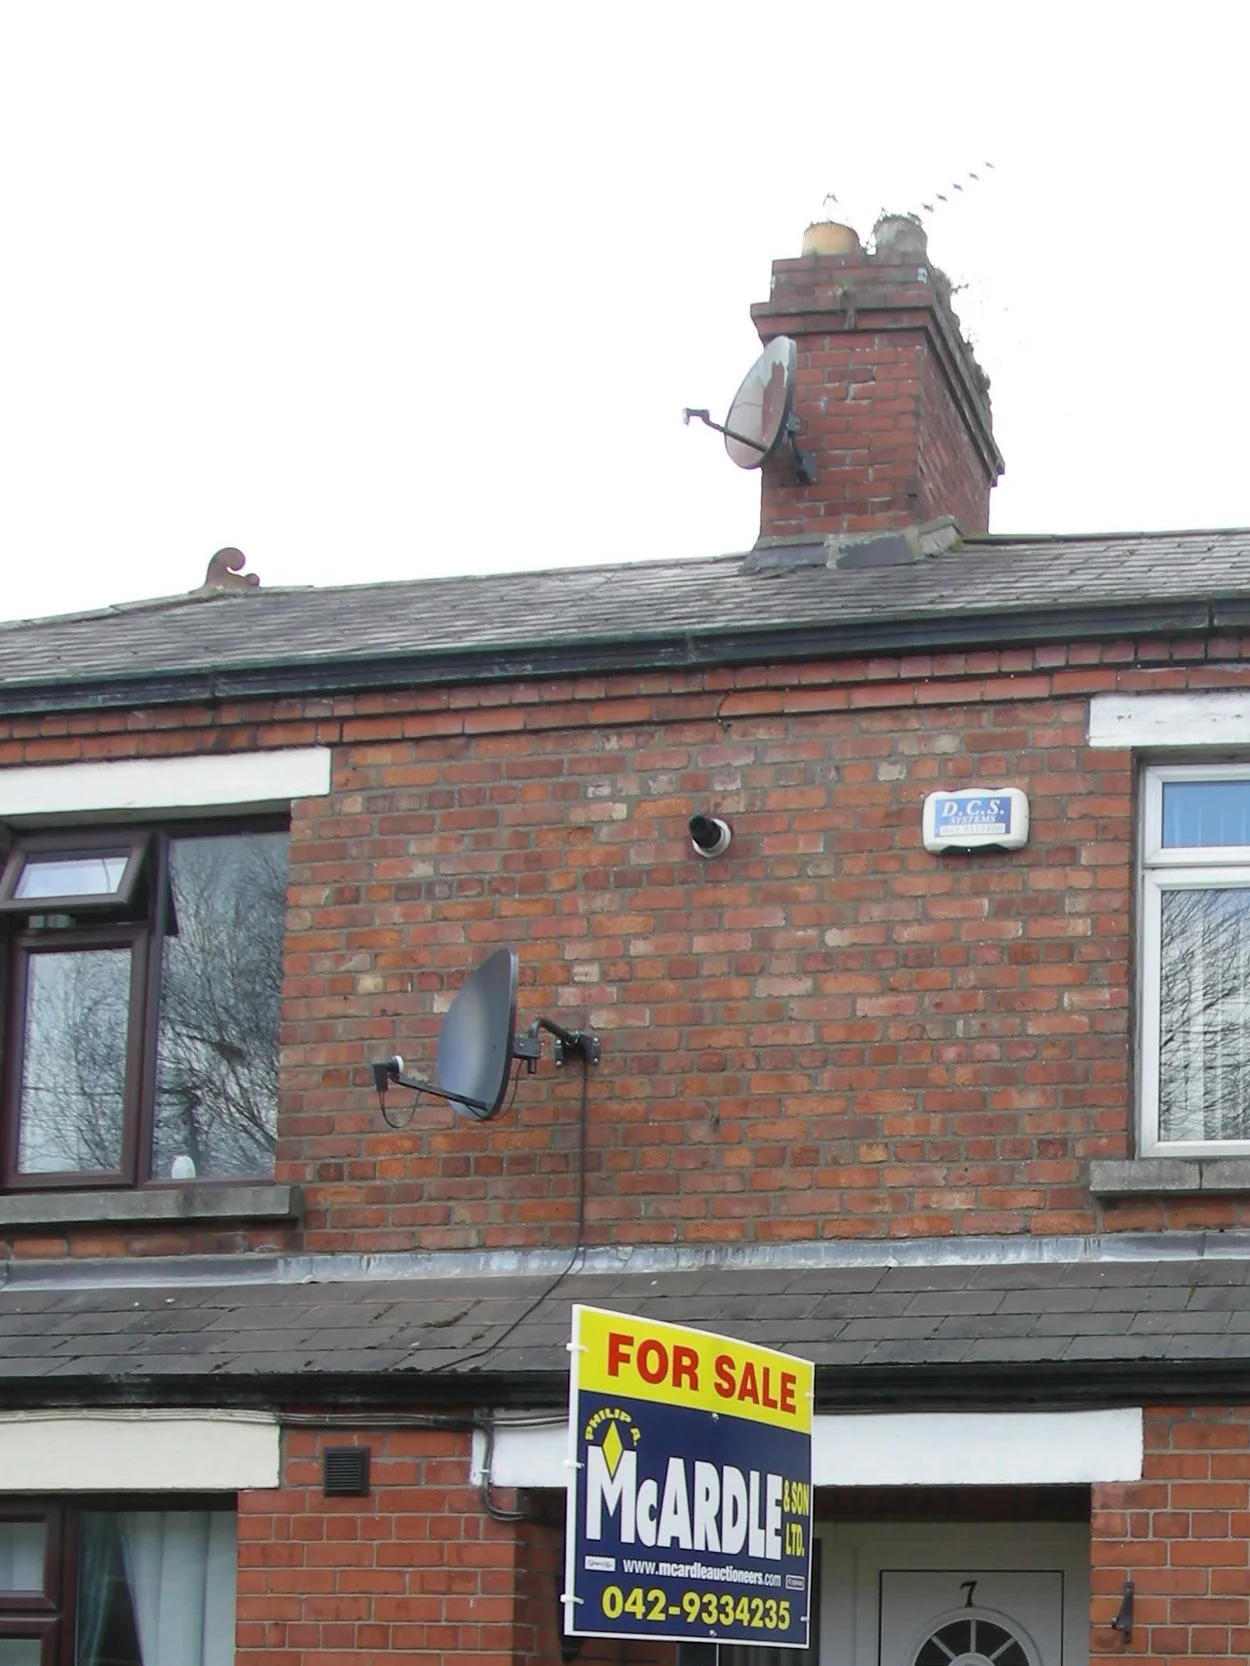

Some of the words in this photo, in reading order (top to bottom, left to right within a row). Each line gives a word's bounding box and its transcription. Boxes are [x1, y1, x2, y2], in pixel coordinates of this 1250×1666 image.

[942, 799, 1005, 817] D.C.S.
[950, 815, 997, 824] SYSTEMS
[607, 1332, 699, 1392] FOR
[714, 1354, 797, 1414] SALE
[585, 1408, 632, 1441] PHILIP
[783, 1479, 790, 1513] &
[791, 1481, 810, 1516] SON
[785, 1523, 805, 1557] LTD.
[623, 1560, 781, 1587] www.mcardleauctioneers.com
[602, 1585, 791, 1630] 042-9334235
[960, 1581, 977, 1607] 7
